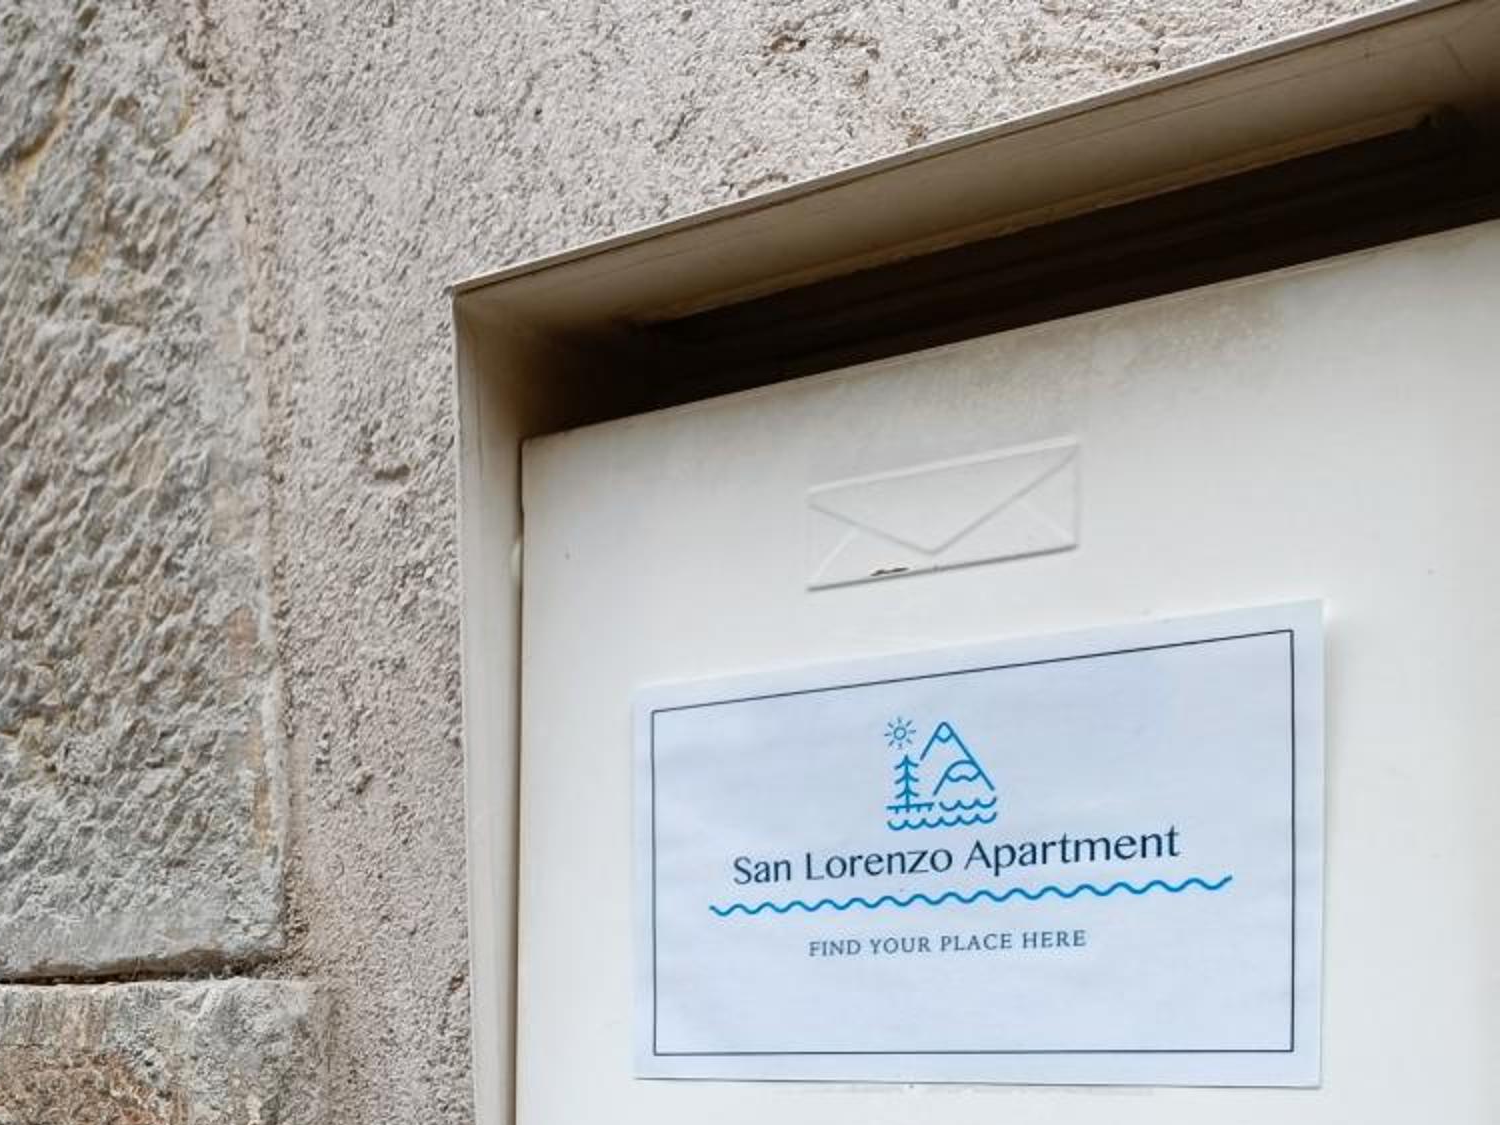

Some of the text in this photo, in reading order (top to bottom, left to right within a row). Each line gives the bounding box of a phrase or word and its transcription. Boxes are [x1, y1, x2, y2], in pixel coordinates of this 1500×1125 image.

[732, 824, 1181, 886] San Lorenzo Apartment
[808, 929, 1087, 958] FIND YOUR PLACE HERE
